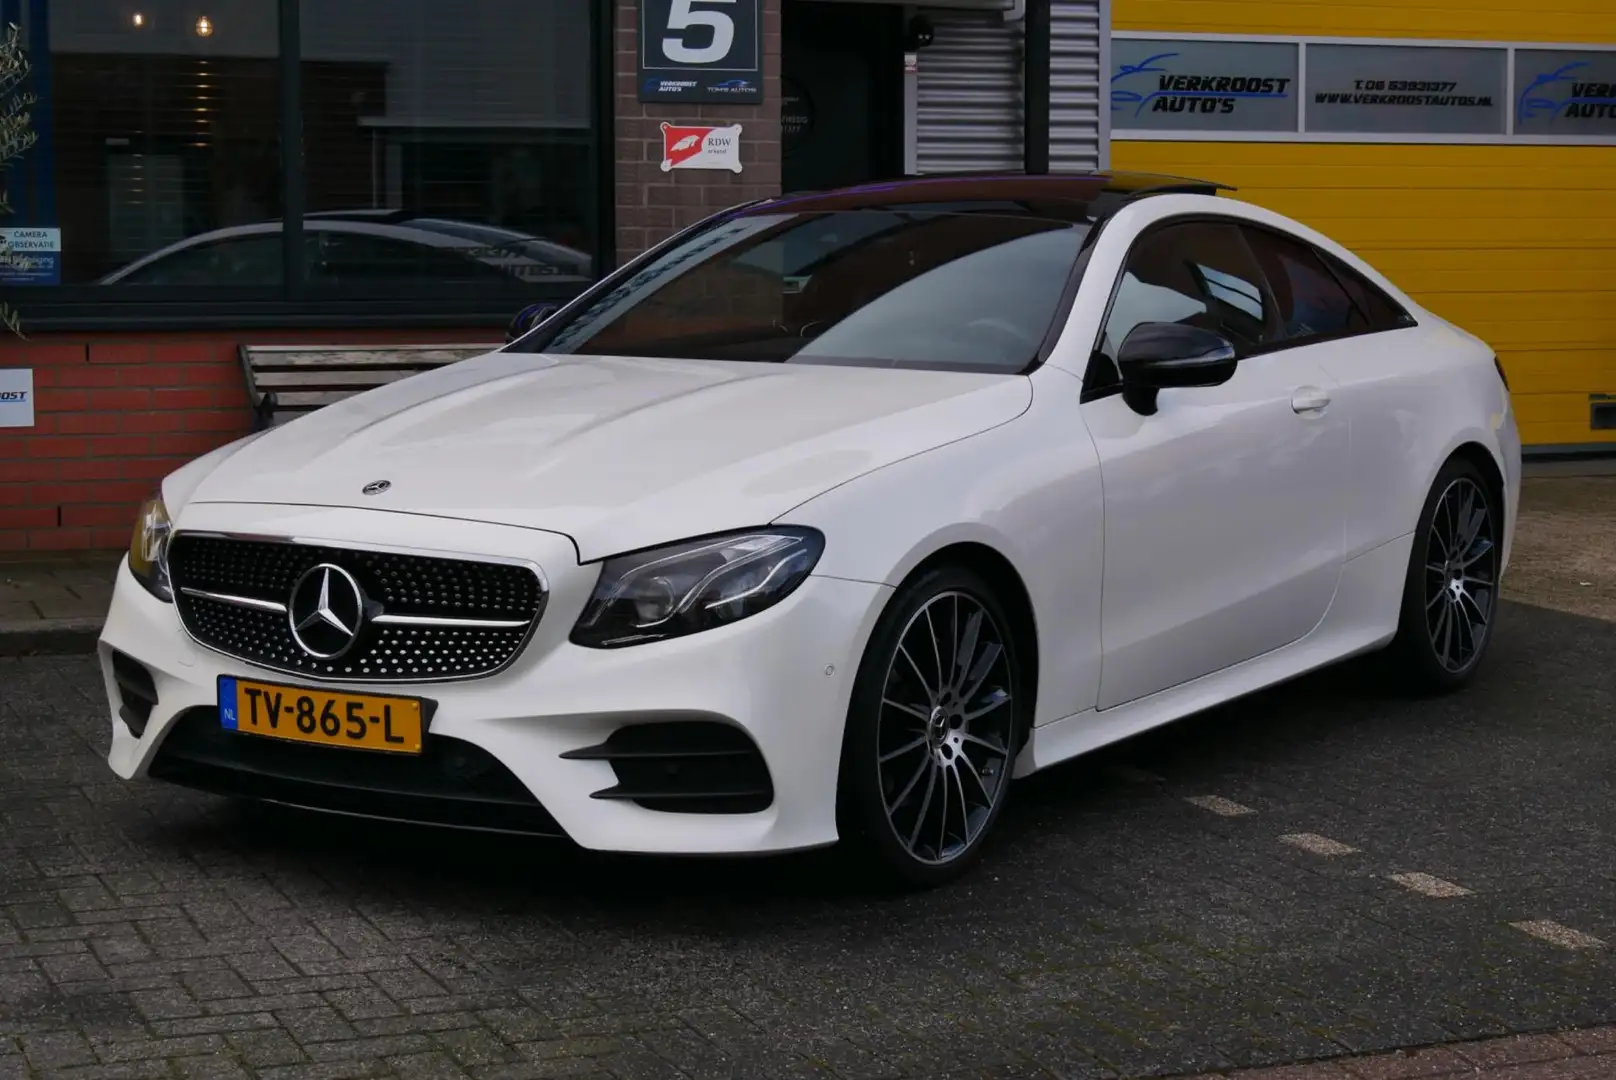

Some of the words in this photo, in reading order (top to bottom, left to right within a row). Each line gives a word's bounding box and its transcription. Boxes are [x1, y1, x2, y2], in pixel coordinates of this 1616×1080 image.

[662, 0, 735, 63] 5
[1160, 75, 1290, 93] VERKROOST
[1152, 97, 1235, 113] AUTO'S
[708, 138, 732, 146] RDW
[8, 240, 54, 248] OBSERVATIE
[224, 708, 236, 721] NL
[244, 687, 405, 744] TV-865-L
